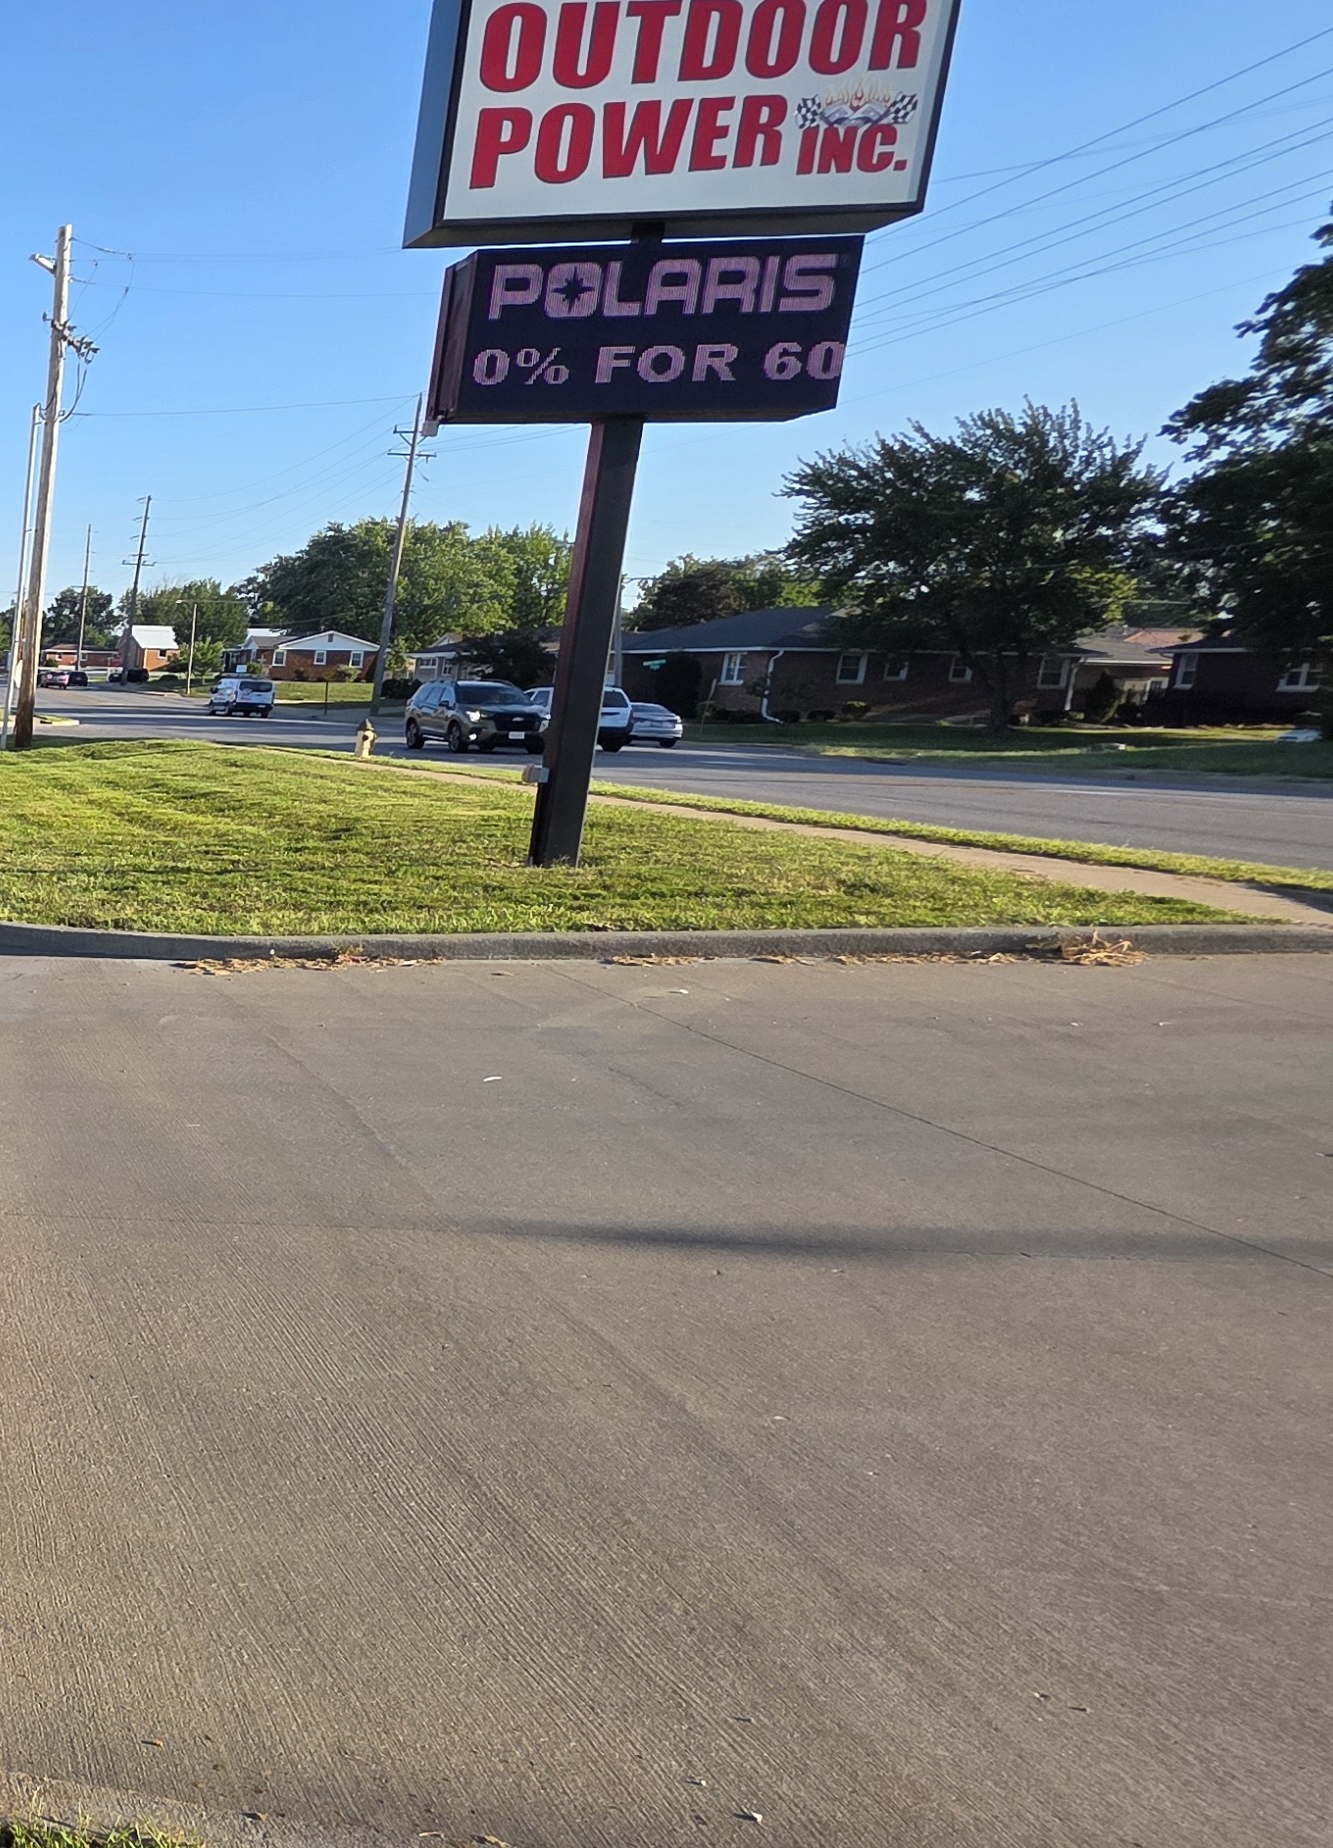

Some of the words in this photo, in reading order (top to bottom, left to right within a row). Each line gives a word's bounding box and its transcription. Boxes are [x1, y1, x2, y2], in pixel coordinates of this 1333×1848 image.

[479, 0, 927, 92] OUTDOOR
[469, 94, 788, 189] POWER
[796, 124, 908, 175] INC.
[488, 253, 839, 320] POLARIS
[472, 347, 570, 386] 0%
[595, 343, 739, 384] FOR
[763, 340, 845, 380] 60
